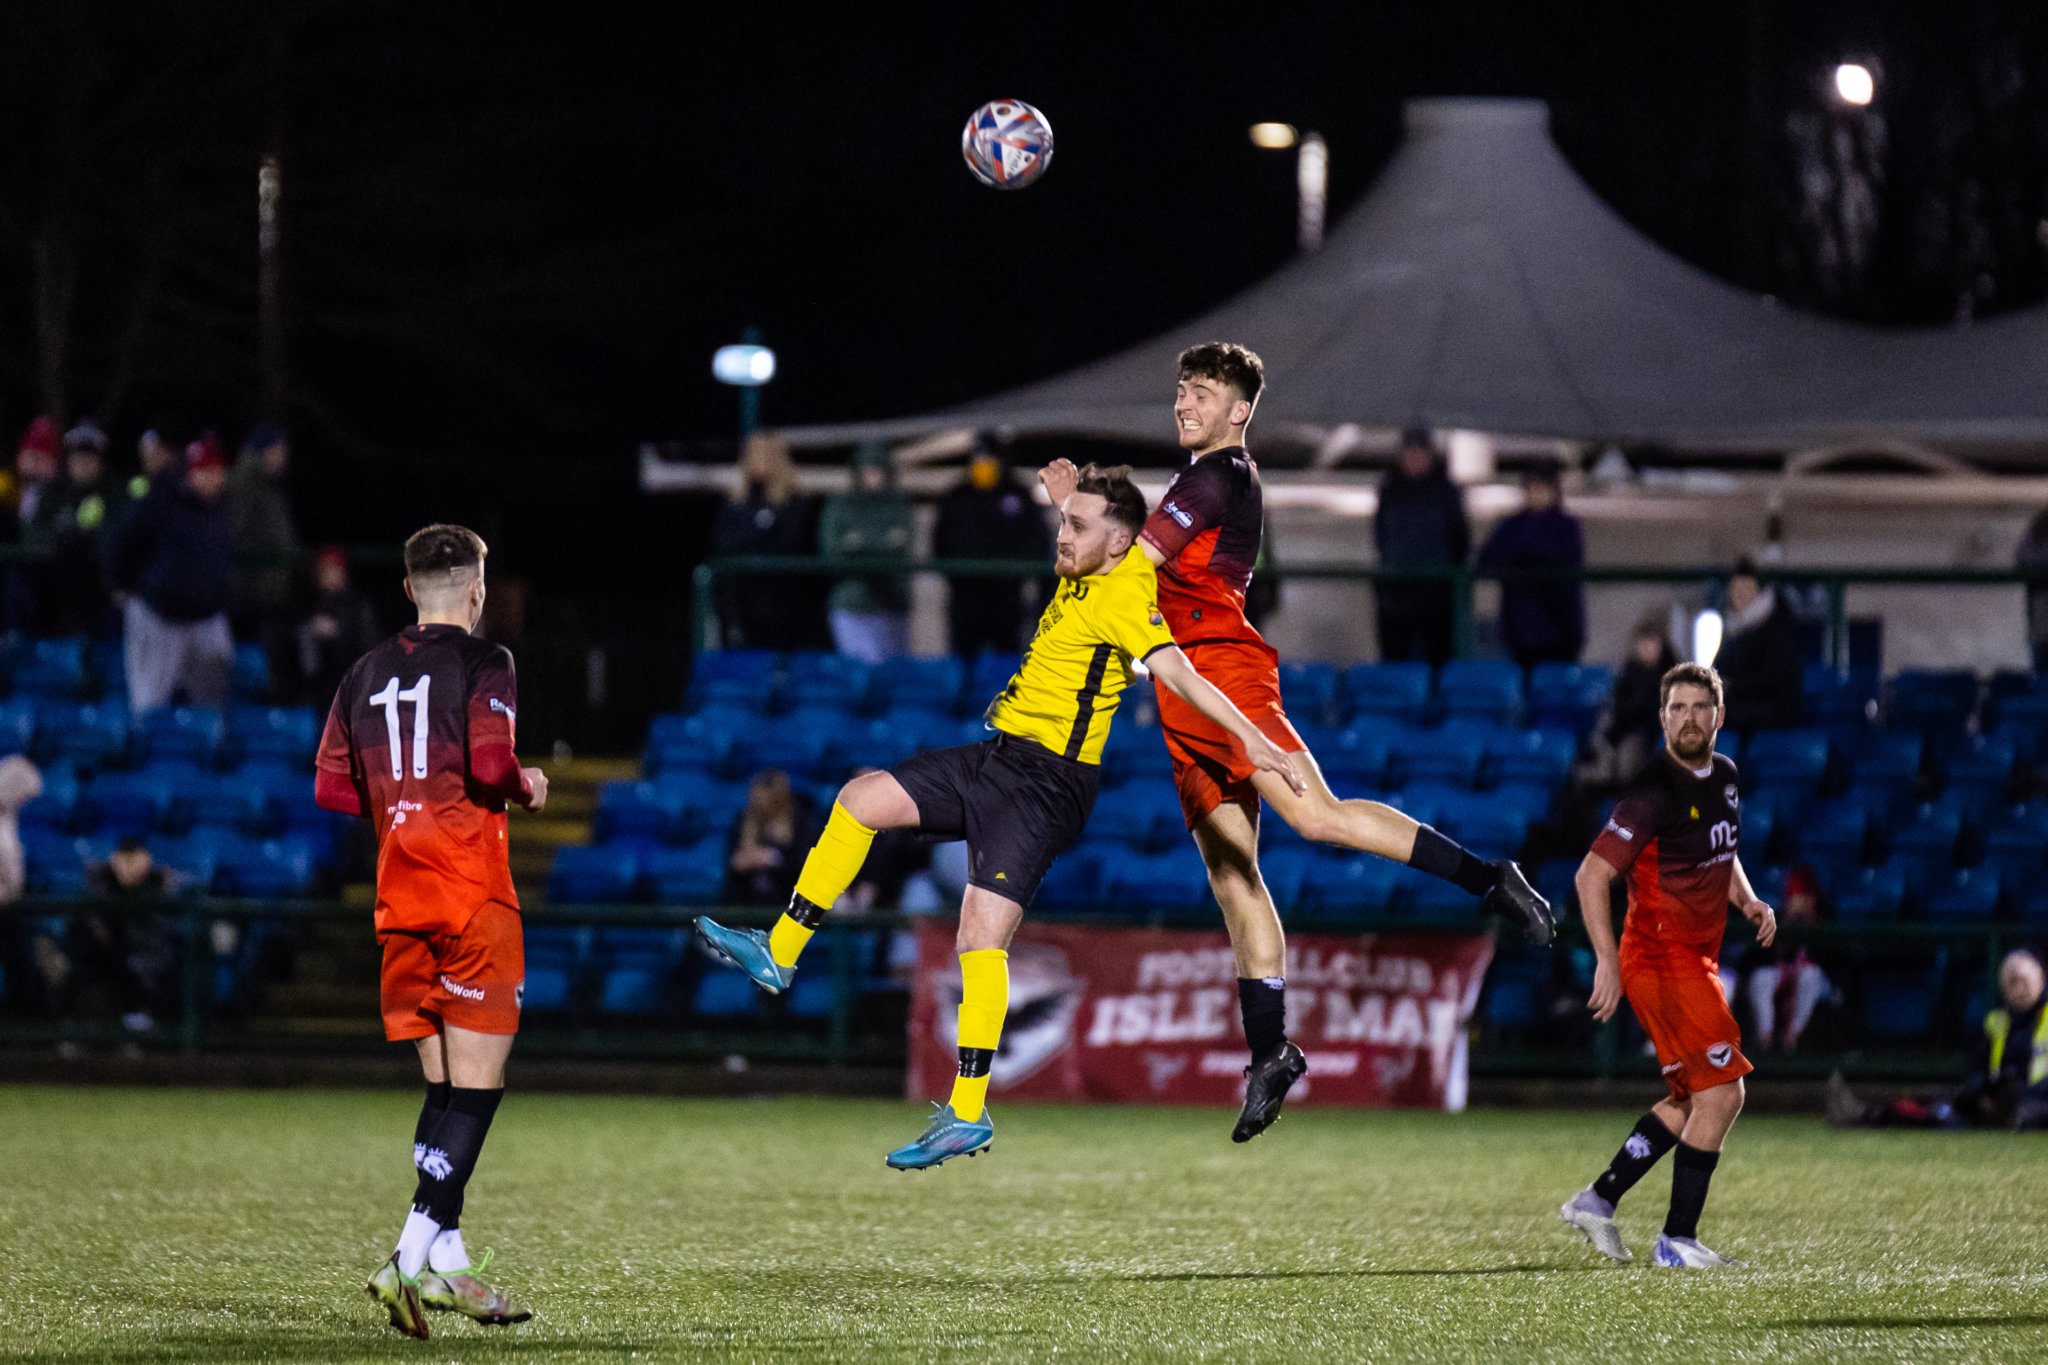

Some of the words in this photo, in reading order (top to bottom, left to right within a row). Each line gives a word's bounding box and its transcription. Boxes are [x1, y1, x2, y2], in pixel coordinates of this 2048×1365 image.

[369, 674, 431, 781] 11
[1138, 948, 1323, 990] FOOTLL
[1088, 989, 1230, 1047] ISLE
